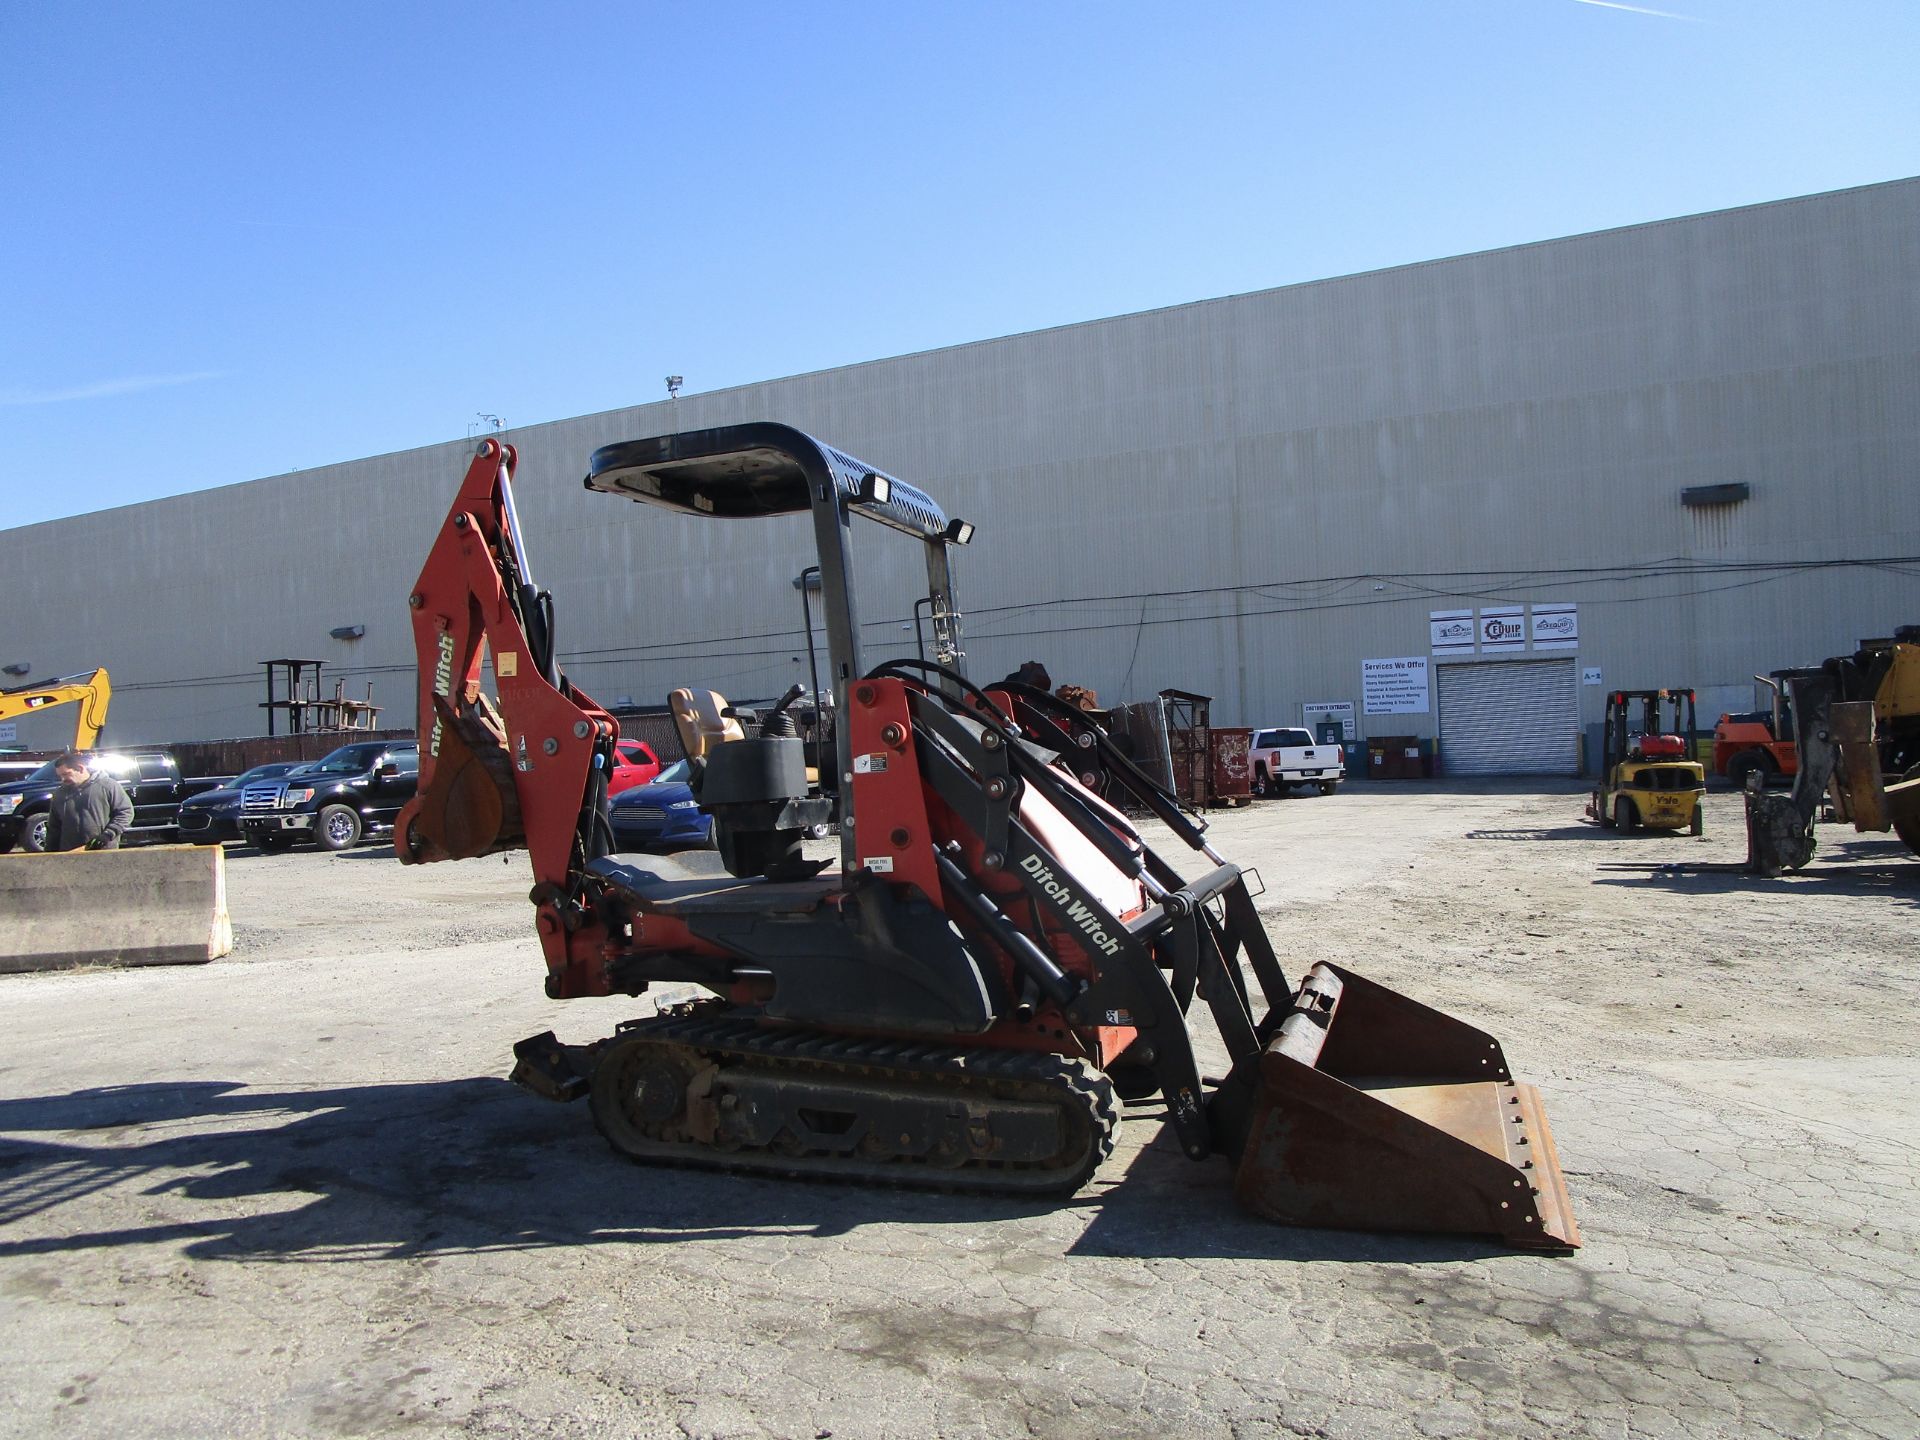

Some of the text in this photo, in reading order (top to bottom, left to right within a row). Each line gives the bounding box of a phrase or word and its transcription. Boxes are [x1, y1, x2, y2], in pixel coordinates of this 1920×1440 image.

[437, 636, 454, 697] Witch
[1394, 661, 1406, 669] We
[1407, 660, 1425, 669] Offer
[31, 697, 44, 707] CAT
[1656, 795, 1679, 805] Yale
[1020, 853, 1119, 956] Ditch Witch
